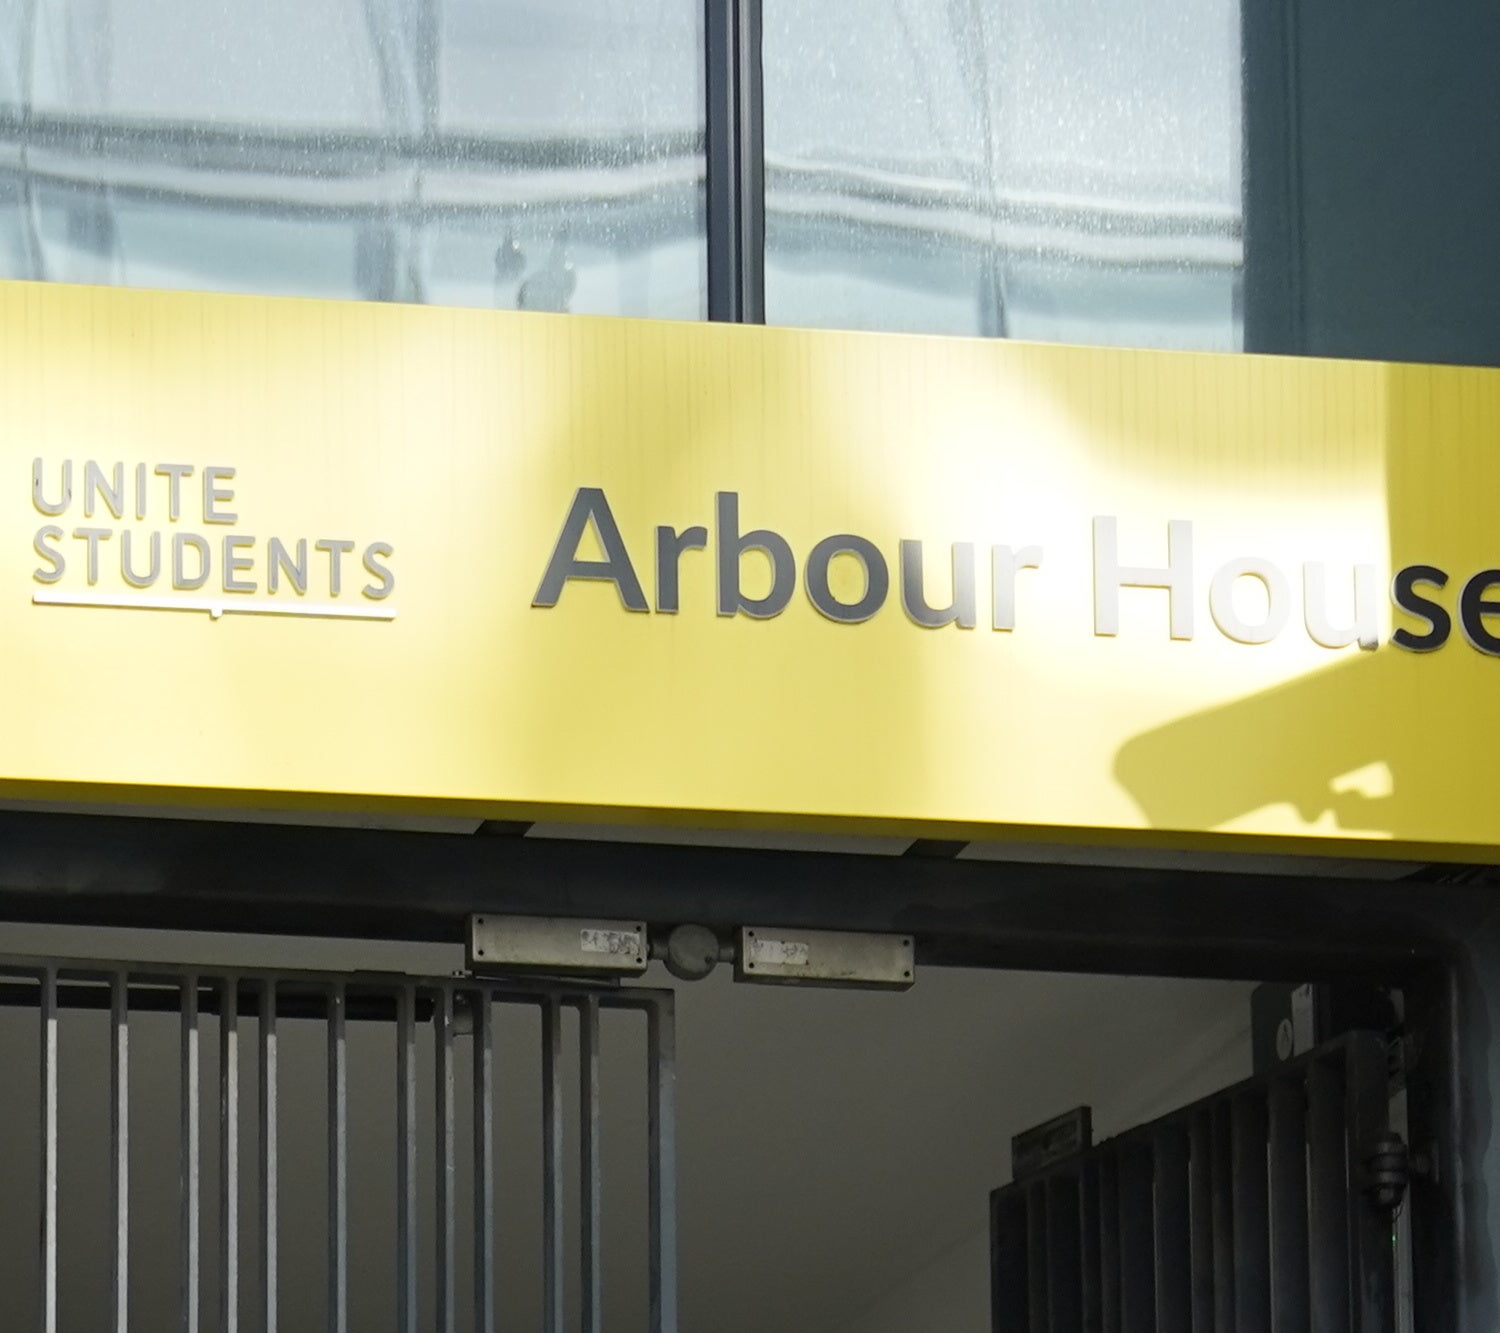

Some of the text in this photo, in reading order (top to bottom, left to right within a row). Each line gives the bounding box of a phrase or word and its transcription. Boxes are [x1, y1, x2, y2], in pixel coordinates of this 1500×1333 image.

[32, 457, 238, 524] UNITE
[32, 525, 396, 600] STUDENTS
[530, 486, 1042, 630] Arbour
